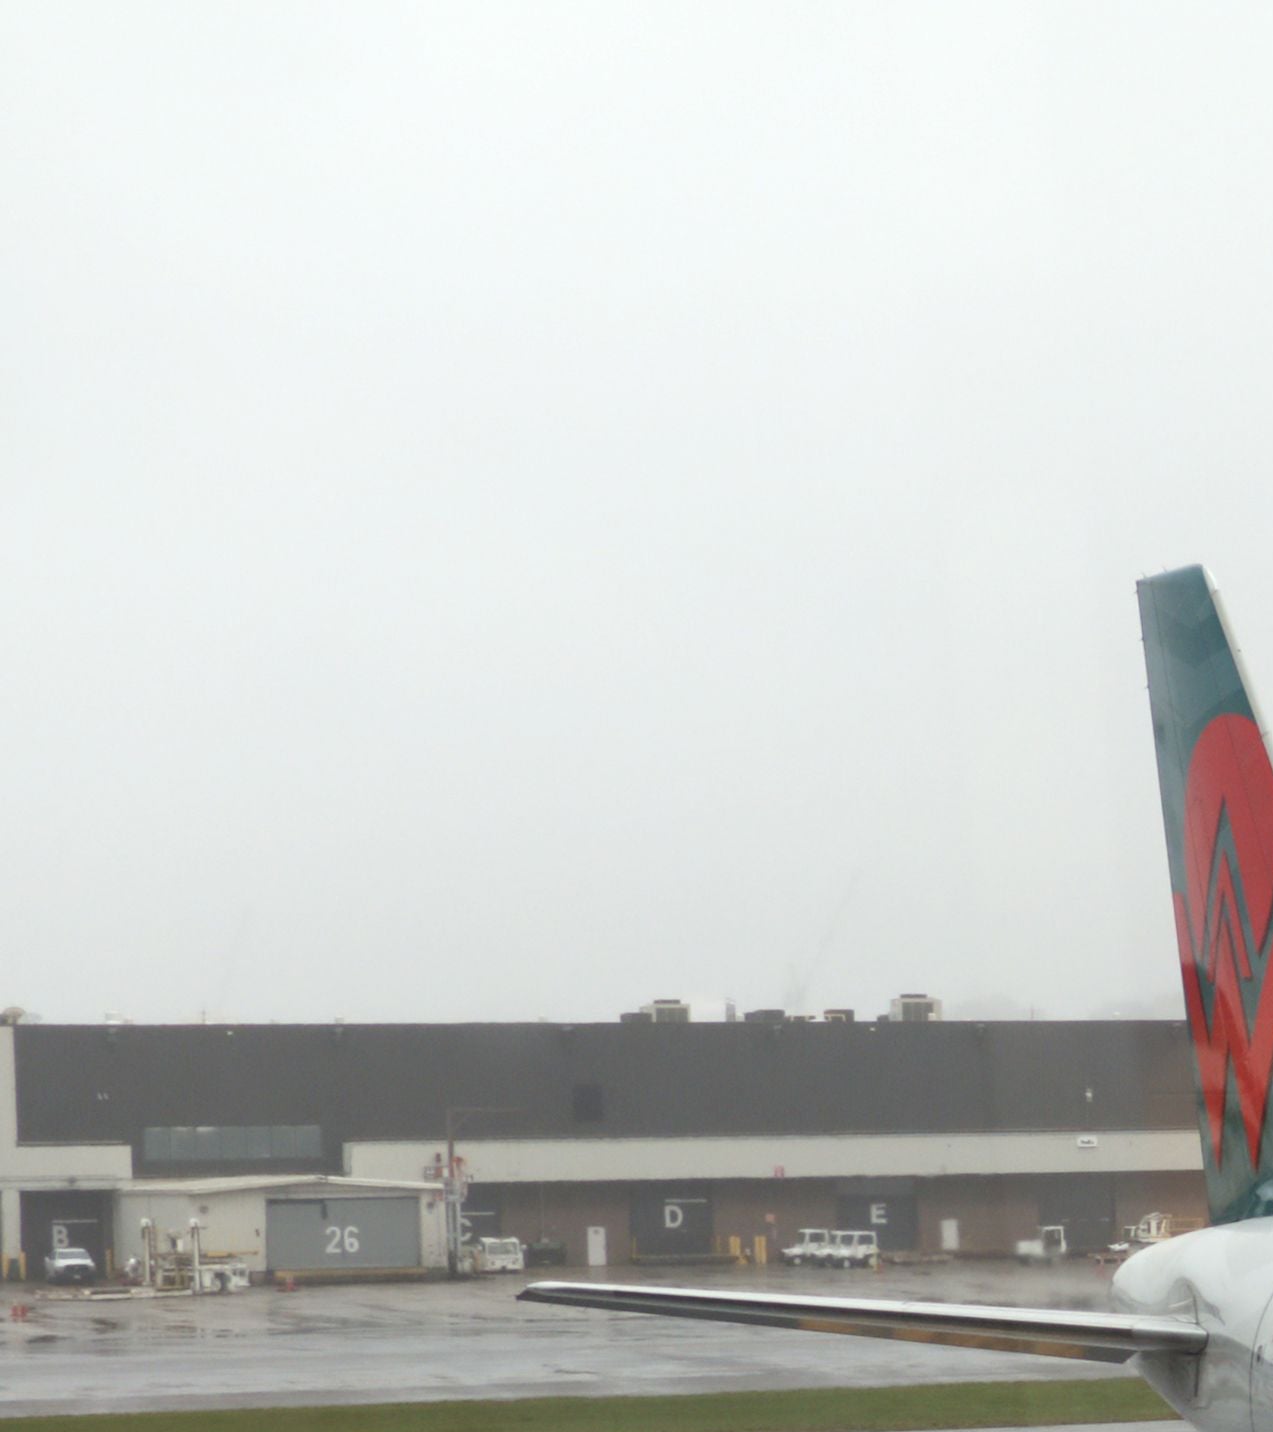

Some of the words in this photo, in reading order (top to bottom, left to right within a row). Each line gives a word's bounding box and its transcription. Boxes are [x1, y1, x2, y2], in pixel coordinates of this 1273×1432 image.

[664, 1204, 684, 1229] D
[870, 1203, 888, 1224] E
[53, 1225, 69, 1248] B
[325, 1226, 361, 1254] 26
